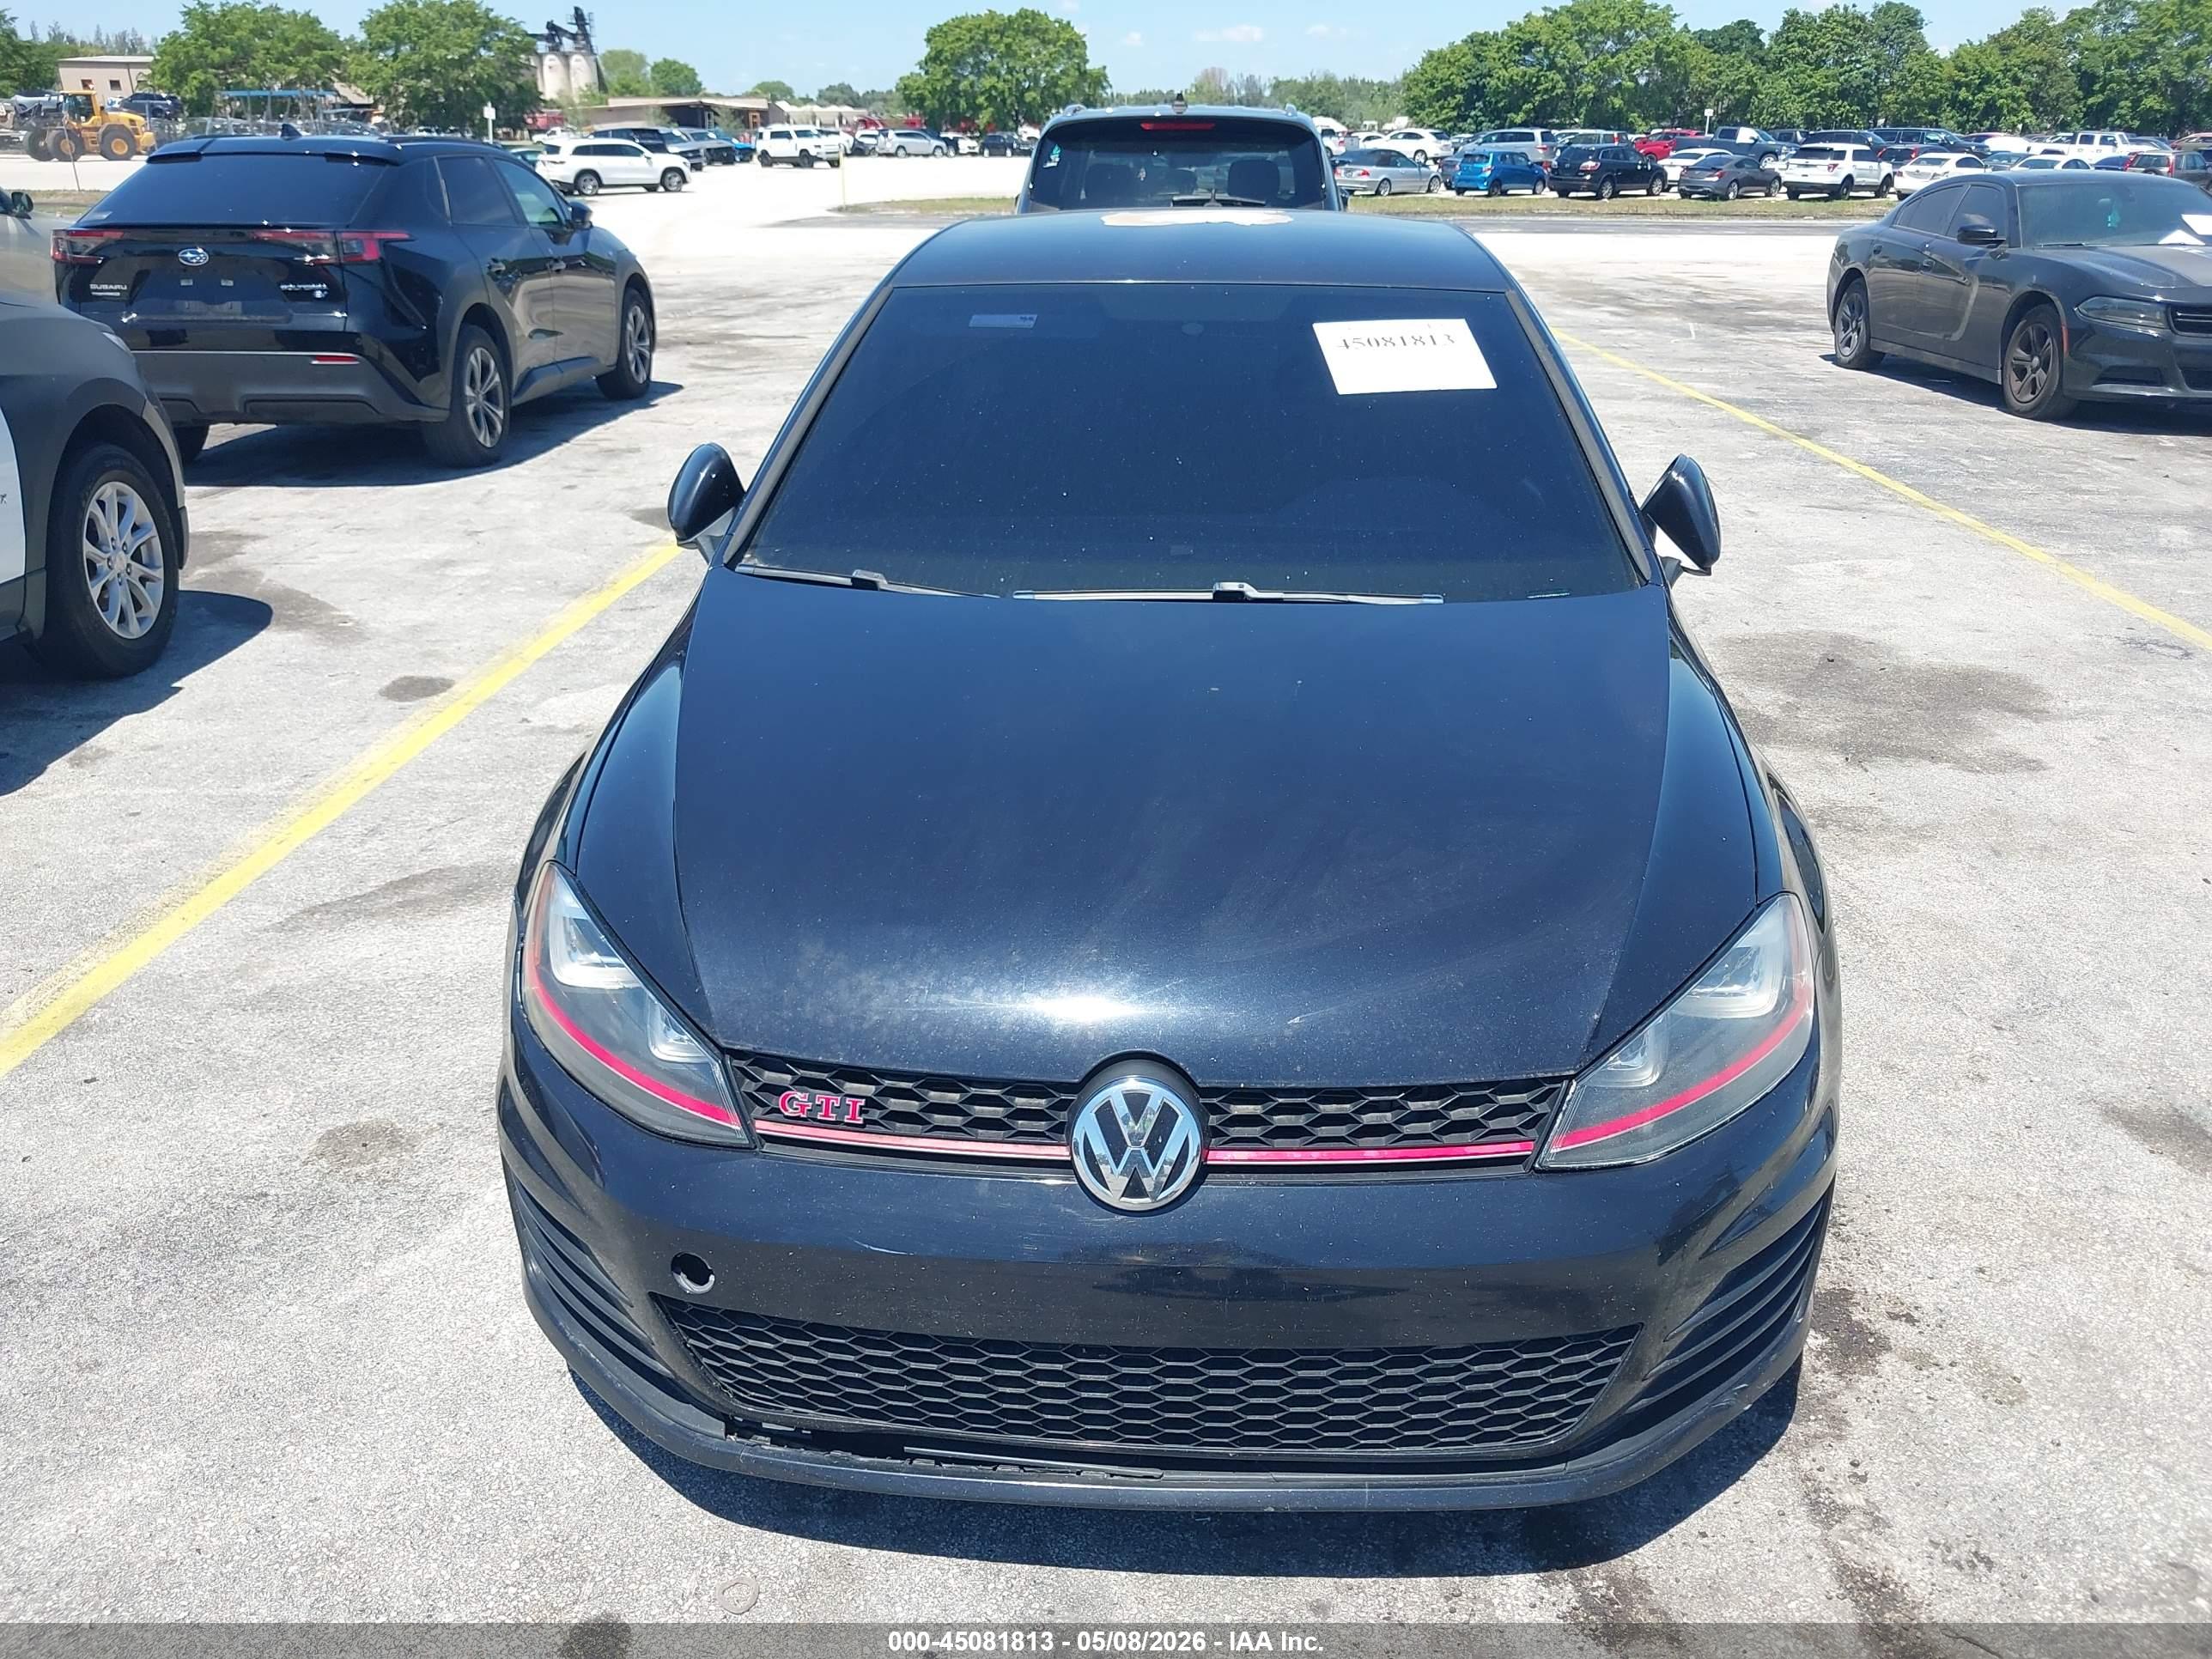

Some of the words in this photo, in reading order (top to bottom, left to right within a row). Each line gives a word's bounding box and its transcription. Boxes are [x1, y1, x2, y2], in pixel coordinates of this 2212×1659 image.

[1337, 333, 1456, 350] 45081813
[778, 1091, 866, 1124] GTI
[1073, 1079, 1200, 1209] VW
